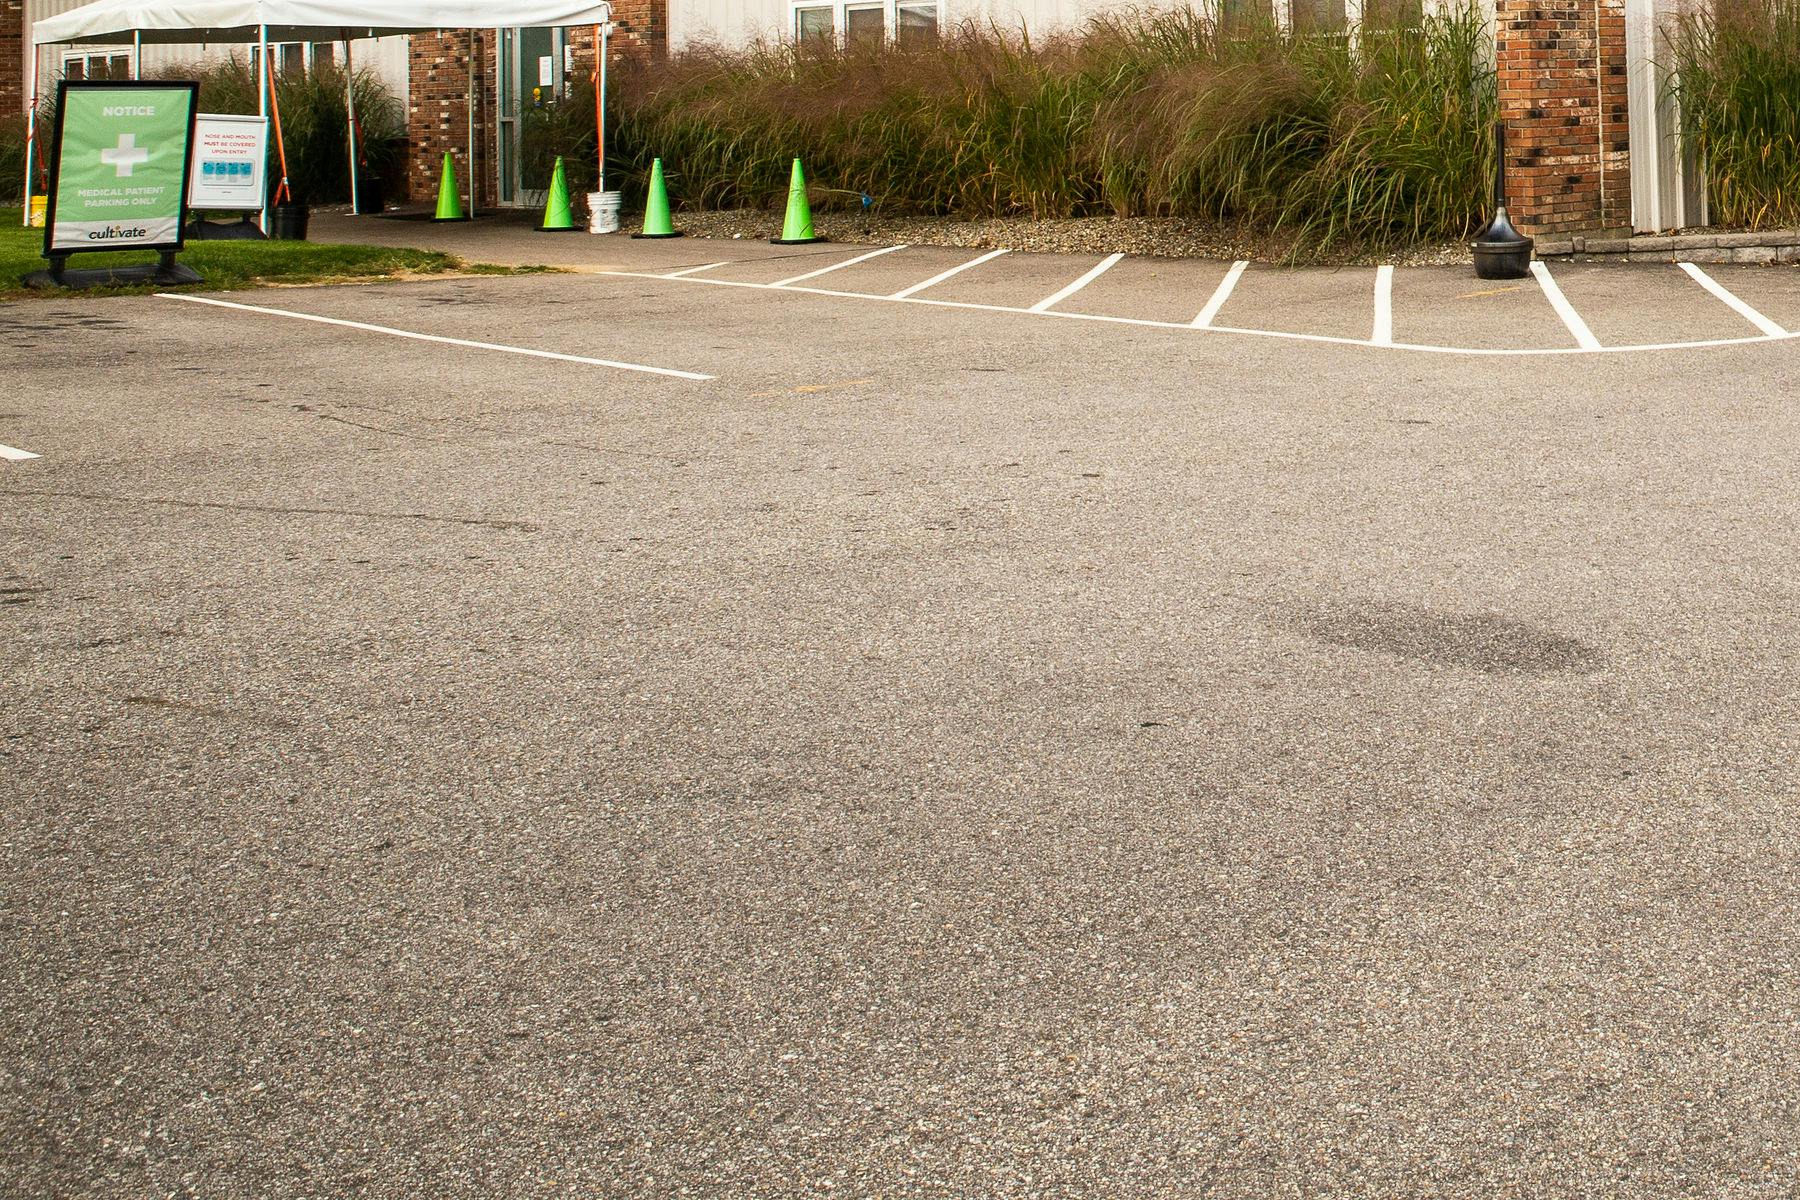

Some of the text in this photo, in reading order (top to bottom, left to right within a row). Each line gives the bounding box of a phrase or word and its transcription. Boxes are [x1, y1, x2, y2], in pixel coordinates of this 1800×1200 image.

[102, 106, 156, 116] NOTICE
[78, 186, 166, 198] MEDICAL PATIENT
[84, 197, 158, 208] PARKING ONLY
[88, 225, 147, 240] cultivate
